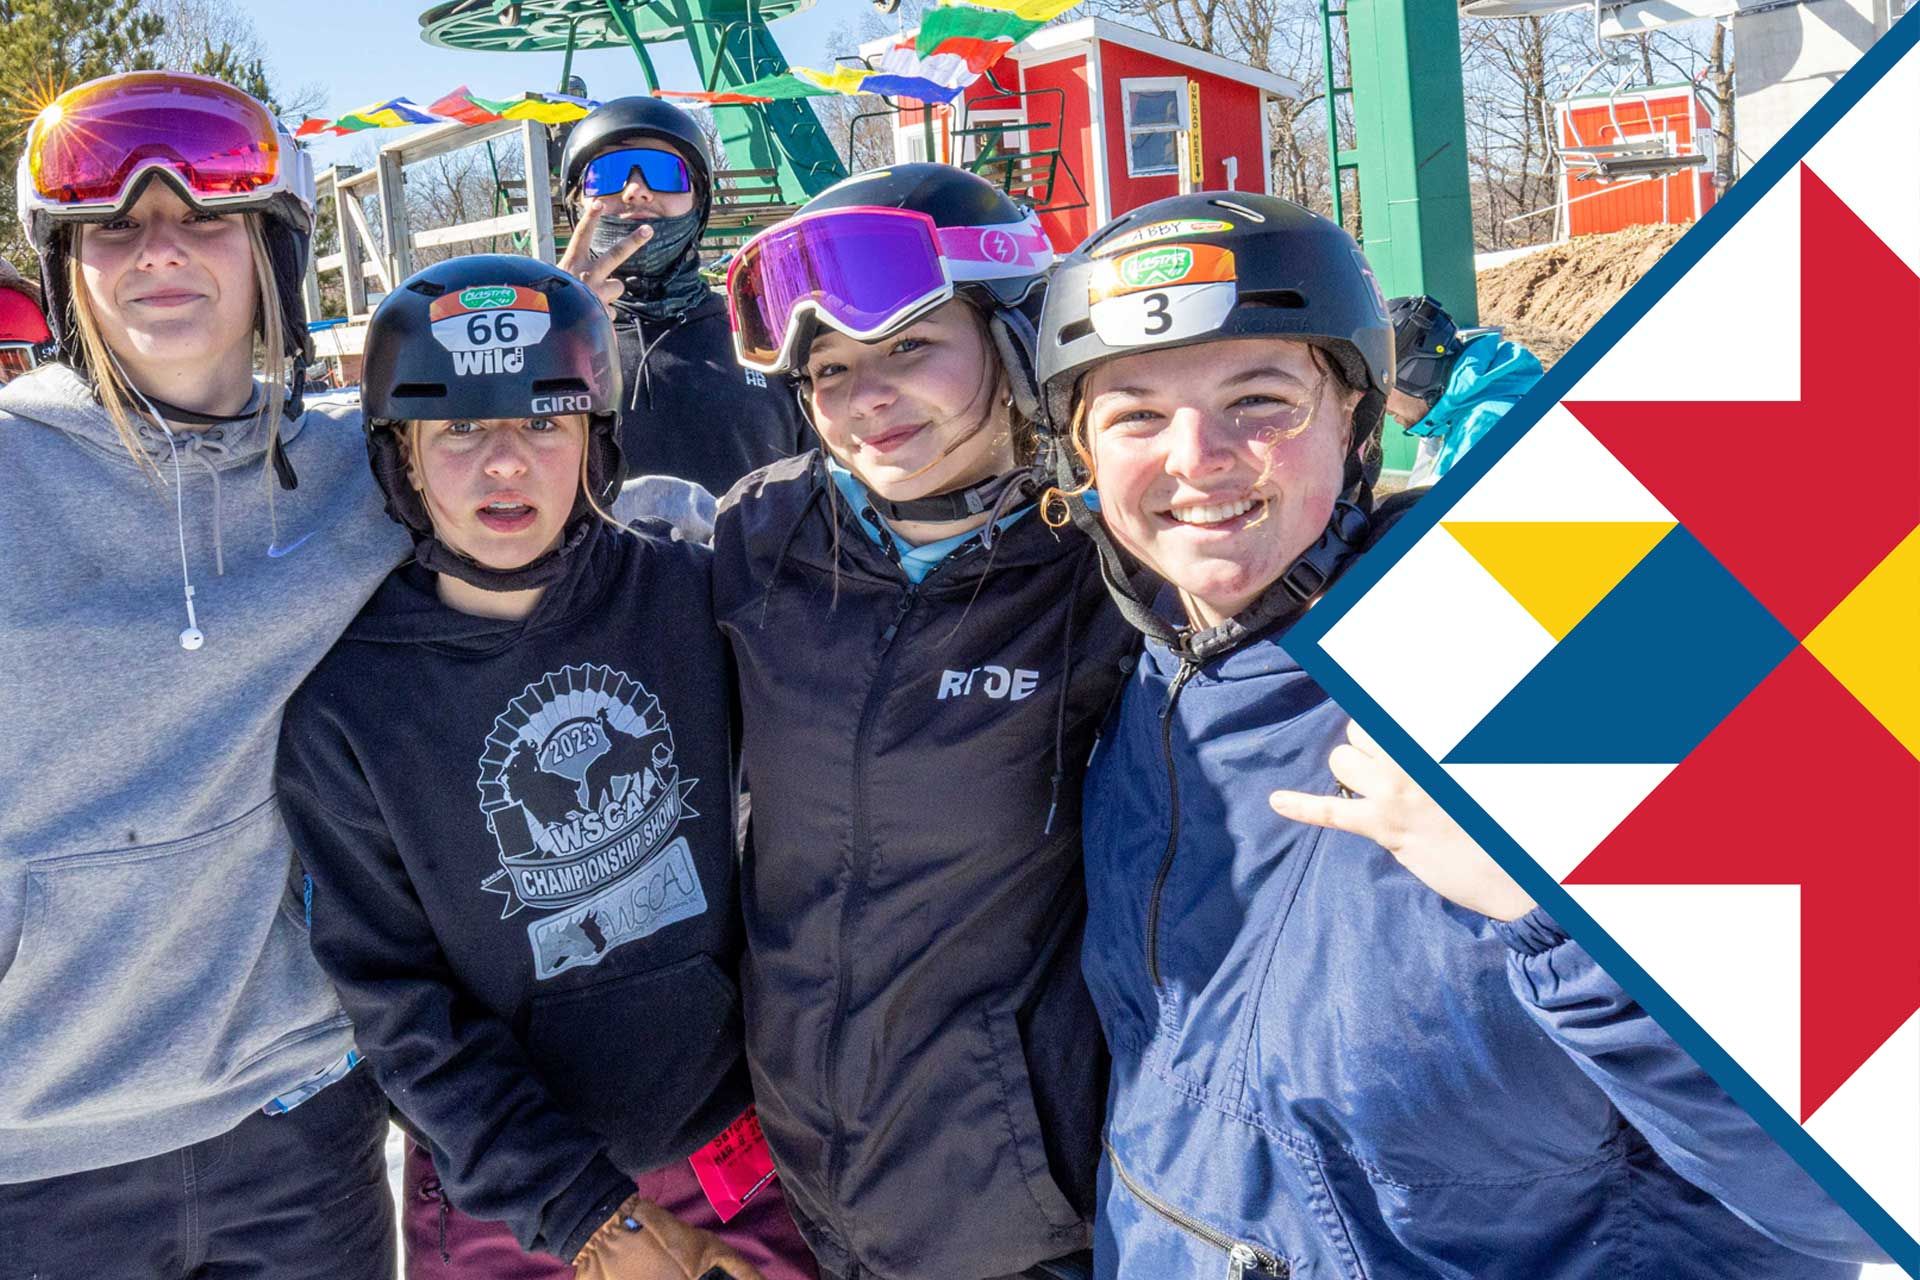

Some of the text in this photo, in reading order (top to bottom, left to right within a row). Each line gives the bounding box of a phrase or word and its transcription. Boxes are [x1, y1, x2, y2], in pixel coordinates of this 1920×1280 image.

[1132, 222, 1181, 241] ABBY
[467, 312, 519, 345] 66
[1143, 292, 1173, 335] 3
[452, 347, 524, 376] Wild
[531, 395, 592, 414] GIRO
[936, 665, 1040, 701] RIDE
[550, 723, 599, 765] 2023
[551, 792, 646, 855] WSCA
[520, 791, 677, 898] CHAMPIONSHIP SHOW
[602, 862, 682, 935] WSCA
